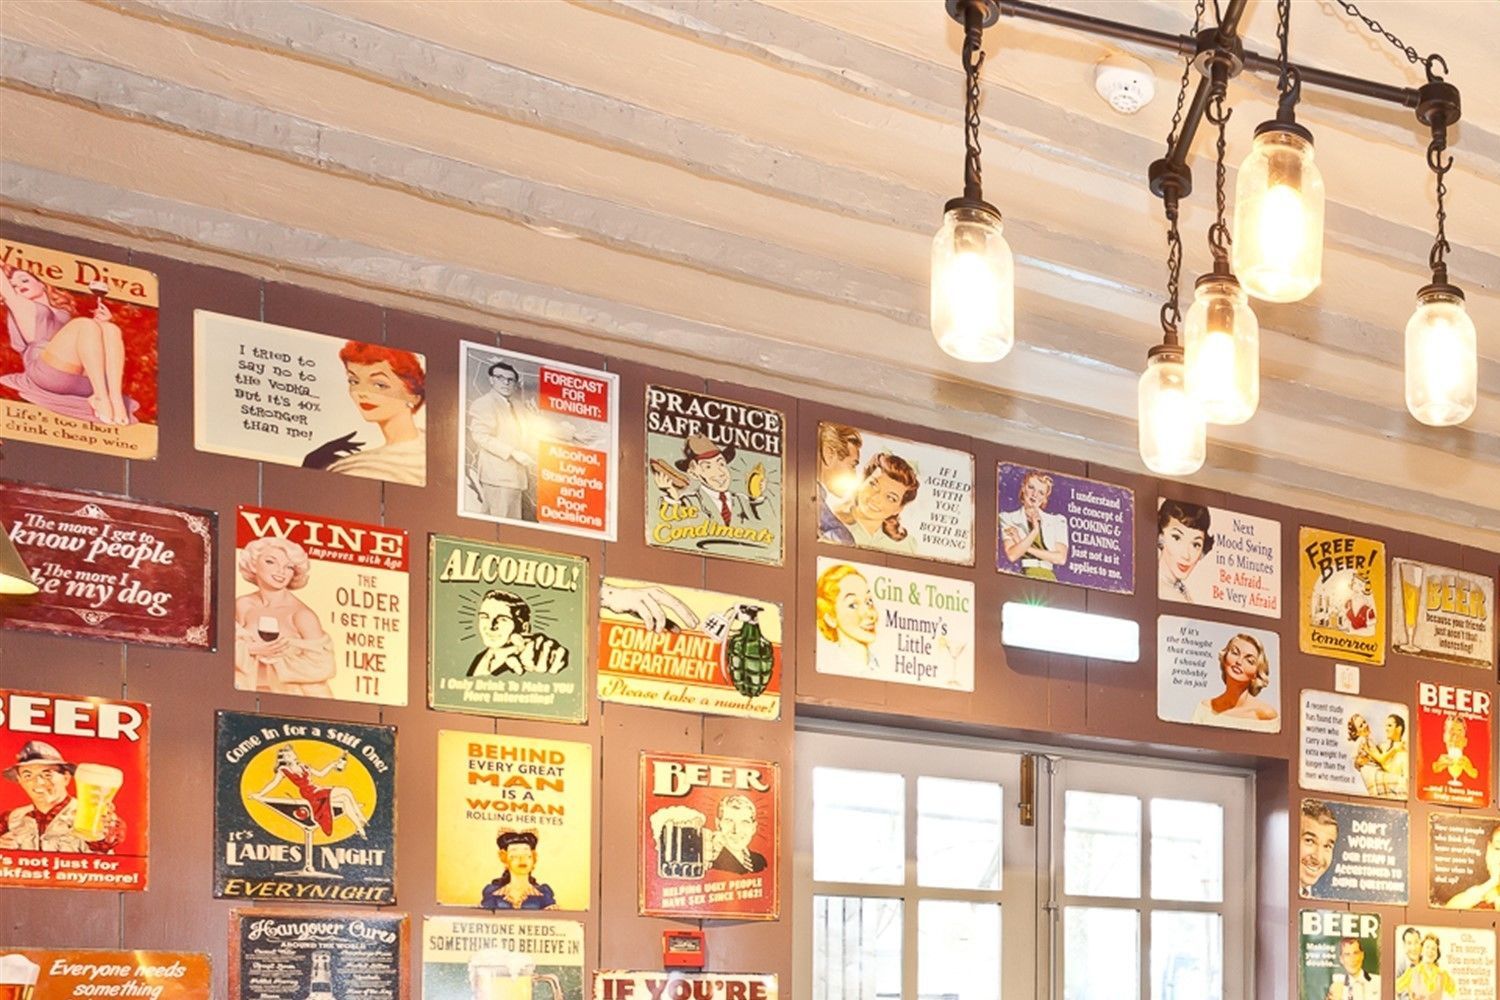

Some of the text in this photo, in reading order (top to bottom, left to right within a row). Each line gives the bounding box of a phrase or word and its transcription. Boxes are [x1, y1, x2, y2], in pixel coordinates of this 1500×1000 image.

[75, 260, 147, 297] Diva
[544, 372, 603, 394] FORECAST
[562, 387, 585, 402] FOR
[548, 397, 601, 417] TONIGHT:
[650, 390, 780, 432] PRACTICE
[6, 407, 120, 435] Life's too short
[6, 420, 139, 450] drink cheap wine
[649, 413, 780, 453] SAFE LUNCH
[549, 447, 600, 466] Alcohol,
[542, 469, 603, 490] Standards
[560, 462, 586, 475] Low
[560, 486, 584, 499] and
[557, 496, 587, 512] Poor
[660, 500, 699, 522] Use
[541, 506, 602, 527] Decisions
[1069, 517, 1121, 536] COOKING &
[1233, 519, 1254, 536] Next
[24, 514, 154, 544] The more I get to
[240, 511, 403, 558] WINE
[654, 520, 774, 544] Condiments
[10, 521, 175, 569] know people
[1217, 534, 1272, 561] Mood Swing
[1305, 538, 1355, 569] FREE
[440, 549, 579, 592] ALCOHOL!
[1216, 551, 1273, 574] in 6 Minutes
[1317, 549, 1378, 584] BEER!
[43, 562, 72, 578] The
[75, 572, 117, 585] more
[119, 573, 129, 586] I
[357, 574, 377, 587] THE
[1220, 569, 1270, 591] Be Afraid...
[65, 580, 113, 608] my
[118, 581, 172, 617] dog
[336, 587, 400, 612] OLDER
[874, 576, 970, 613] Gin & Tonic
[1213, 585, 1276, 609] Be Very Afraid
[1426, 574, 1488, 620] BEER
[331, 612, 400, 632] I GET THE
[705, 618, 725, 636] #1
[885, 609, 948, 639] Mummy's
[346, 634, 385, 649] MORE
[608, 626, 718, 659] COMPLAINT
[898, 633, 932, 655] Little
[1311, 629, 1377, 652] tomorrow
[346, 652, 386, 672] I LIKE
[609, 649, 718, 681] DEPARTMENT
[895, 655, 938, 681] Helper
[356, 676, 380, 696] IT!
[602, 678, 659, 698] Please
[663, 687, 695, 704] take
[715, 701, 776, 714] number!
[1419, 682, 1490, 714] BEER
[0, 695, 143, 741] EER
[468, 743, 565, 765] BEHIND
[469, 760, 564, 777] EVERY GREAT
[652, 761, 770, 796] BEER
[467, 772, 564, 792] MAN
[502, 790, 535, 800] IS A
[466, 798, 564, 816] WOMAN
[467, 811, 563, 826] ROLLING HER EYES
[1352, 820, 1388, 836] DON'T
[19, 858, 119, 870] not just for
[56, 871, 139, 883] anymore!
[224, 879, 390, 900] EVERYNIGHT
[248, 919, 397, 943] Hangover Cures
[452, 923, 514, 935] EVERYONE
[1302, 912, 1379, 938] BEER
[429, 936, 497, 951] SOMETHING
[502, 939, 515, 952] TO
[519, 939, 565, 954] BELIEVE
[50, 959, 187, 980] Everyone needs
[73, 980, 164, 1000] something
[603, 979, 635, 1000] IF
